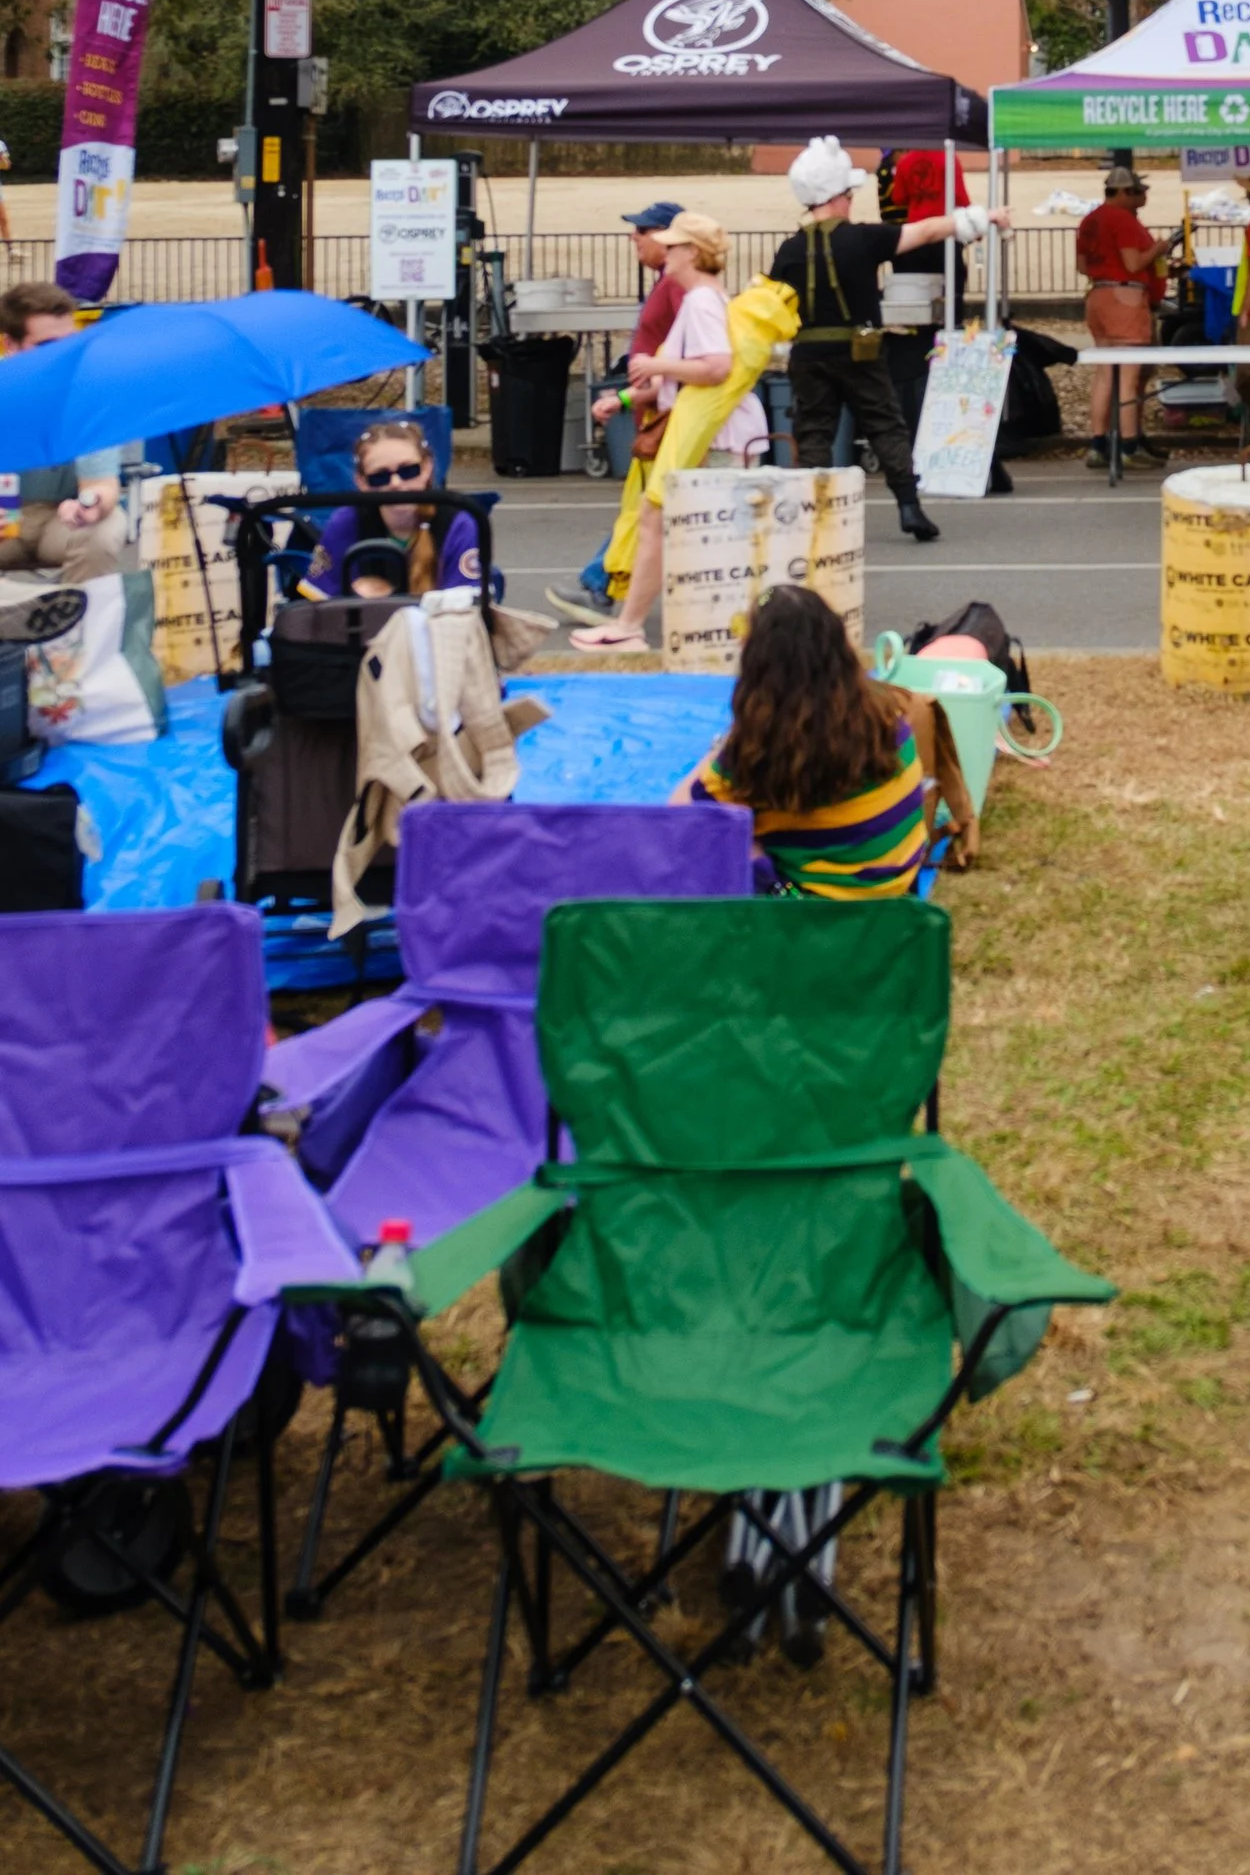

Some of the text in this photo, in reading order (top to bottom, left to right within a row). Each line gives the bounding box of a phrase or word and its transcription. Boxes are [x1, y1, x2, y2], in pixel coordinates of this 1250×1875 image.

[612, 53, 783, 74] OSPREY
[1083, 95, 1160, 125] RECYCLE
[1163, 94, 1210, 124] HERE
[676, 569, 725, 585] WHITE
[729, 565, 770, 580] CAP
[1178, 571, 1227, 587] WHITE
[683, 628, 734, 645] WHITE
[1184, 630, 1240, 647] WHITE
